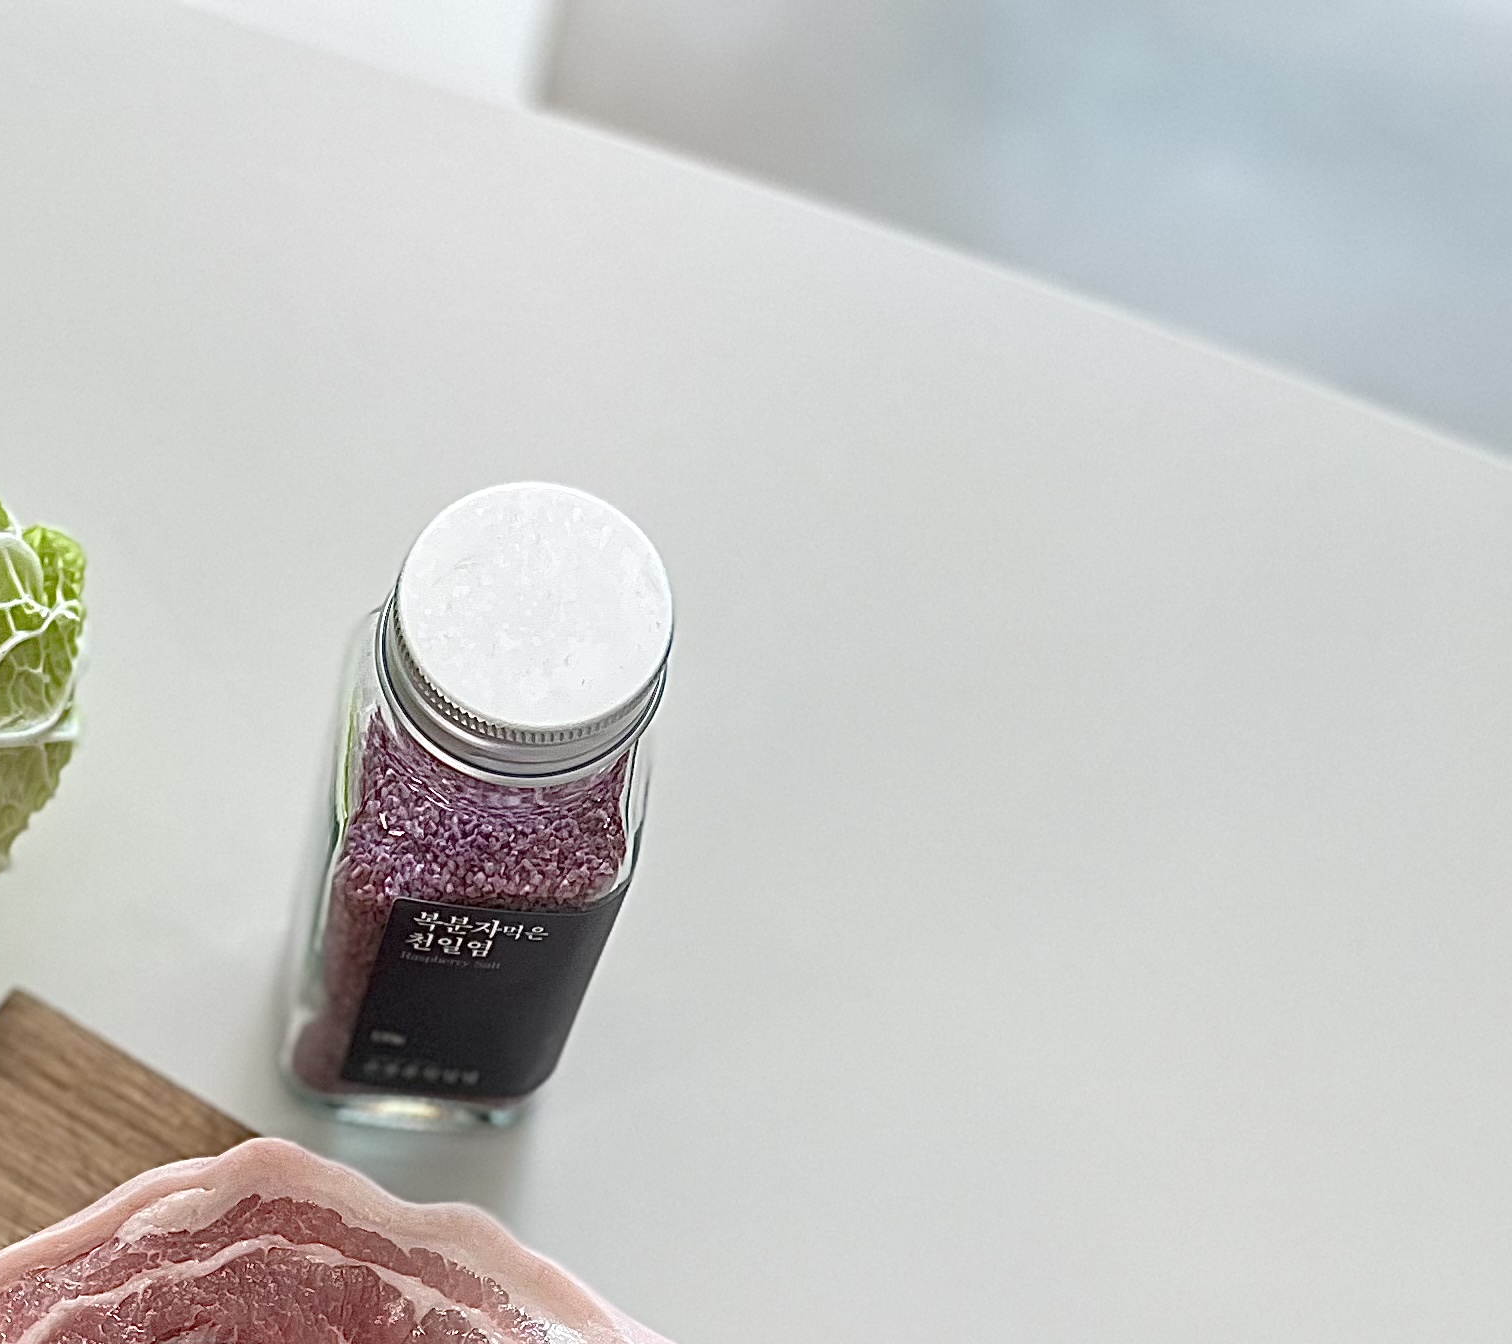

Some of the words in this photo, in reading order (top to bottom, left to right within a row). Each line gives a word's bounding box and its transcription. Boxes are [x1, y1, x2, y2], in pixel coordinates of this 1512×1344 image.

[413, 911, 549, 941] 복분자먹은
[404, 932, 493, 958] 천일염
[400, 951, 468, 967] Raspberry
[473, 961, 501, 970] Salt
